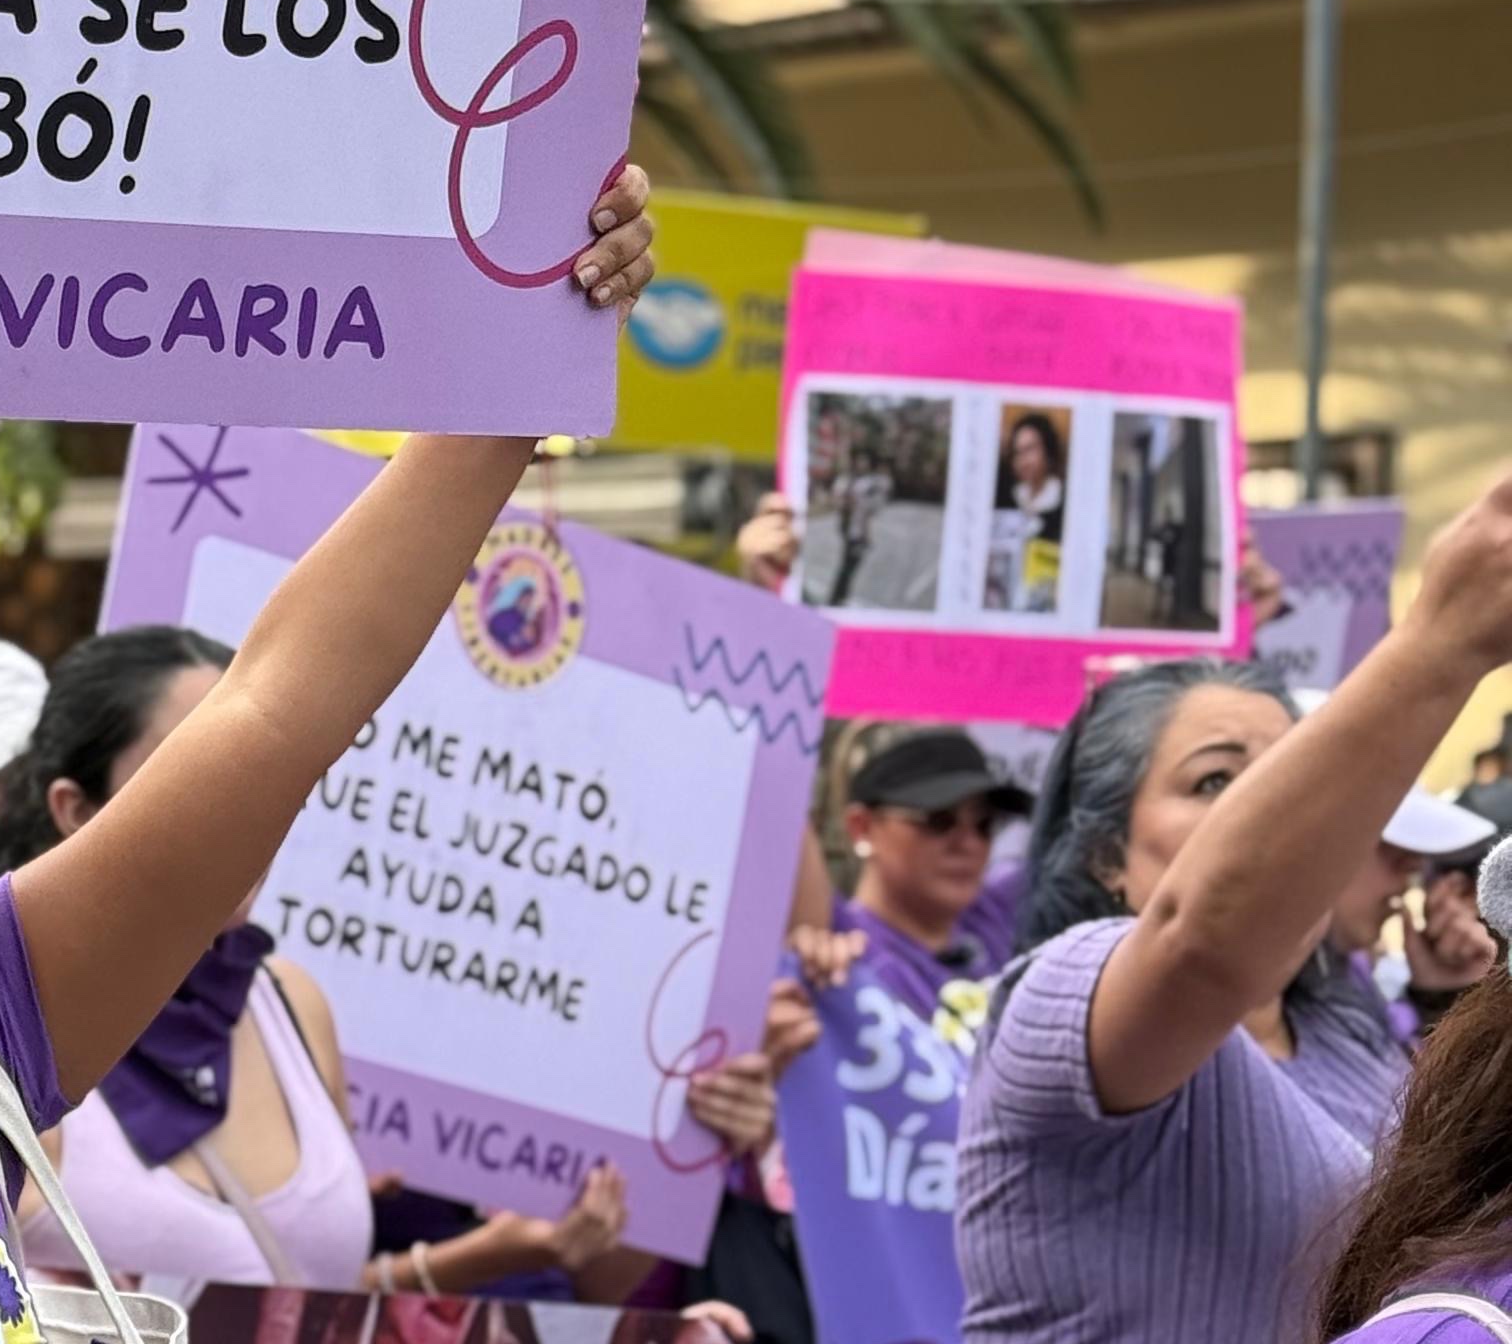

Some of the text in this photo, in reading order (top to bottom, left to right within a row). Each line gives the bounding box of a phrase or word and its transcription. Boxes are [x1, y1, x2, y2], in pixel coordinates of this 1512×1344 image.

[392, 722, 460, 780] ME
[472, 747, 617, 831] MATÓ,
[320, 773, 709, 924] UE EL JUZGADO LE
[340, 847, 543, 940] AYUDA A
[278, 897, 585, 1023] TORTURARME
